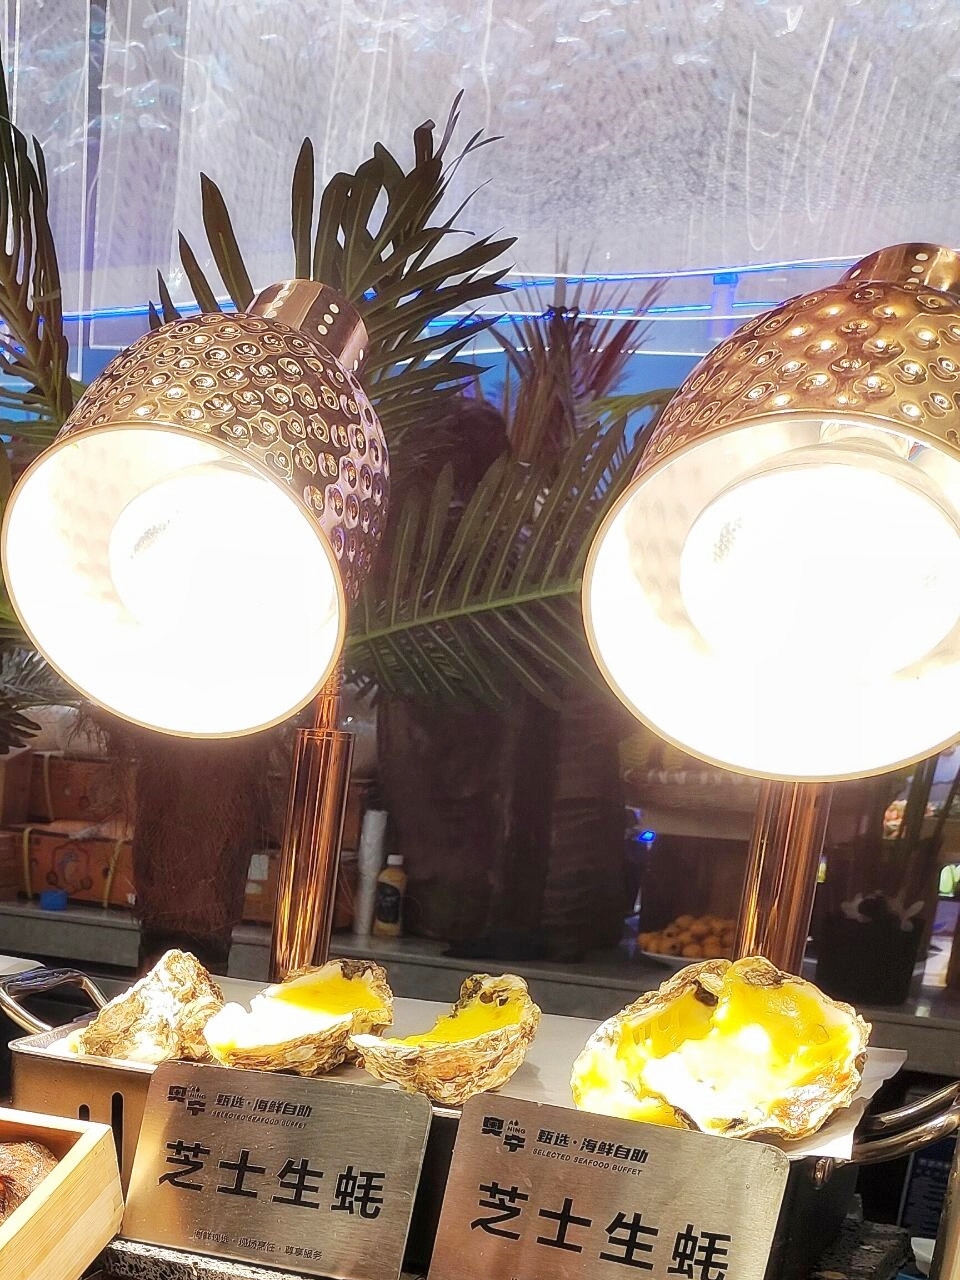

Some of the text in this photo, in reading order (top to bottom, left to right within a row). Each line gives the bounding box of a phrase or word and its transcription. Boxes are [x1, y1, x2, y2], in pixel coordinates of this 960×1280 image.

[507, 1126, 526, 1135] NING
[532, 1148, 644, 1176] SELECTED SEAFOOD BUFFET
[536, 1129, 650, 1164] 甄选·海鲜自助
[158, 1139, 388, 1220] 芝士生蚝
